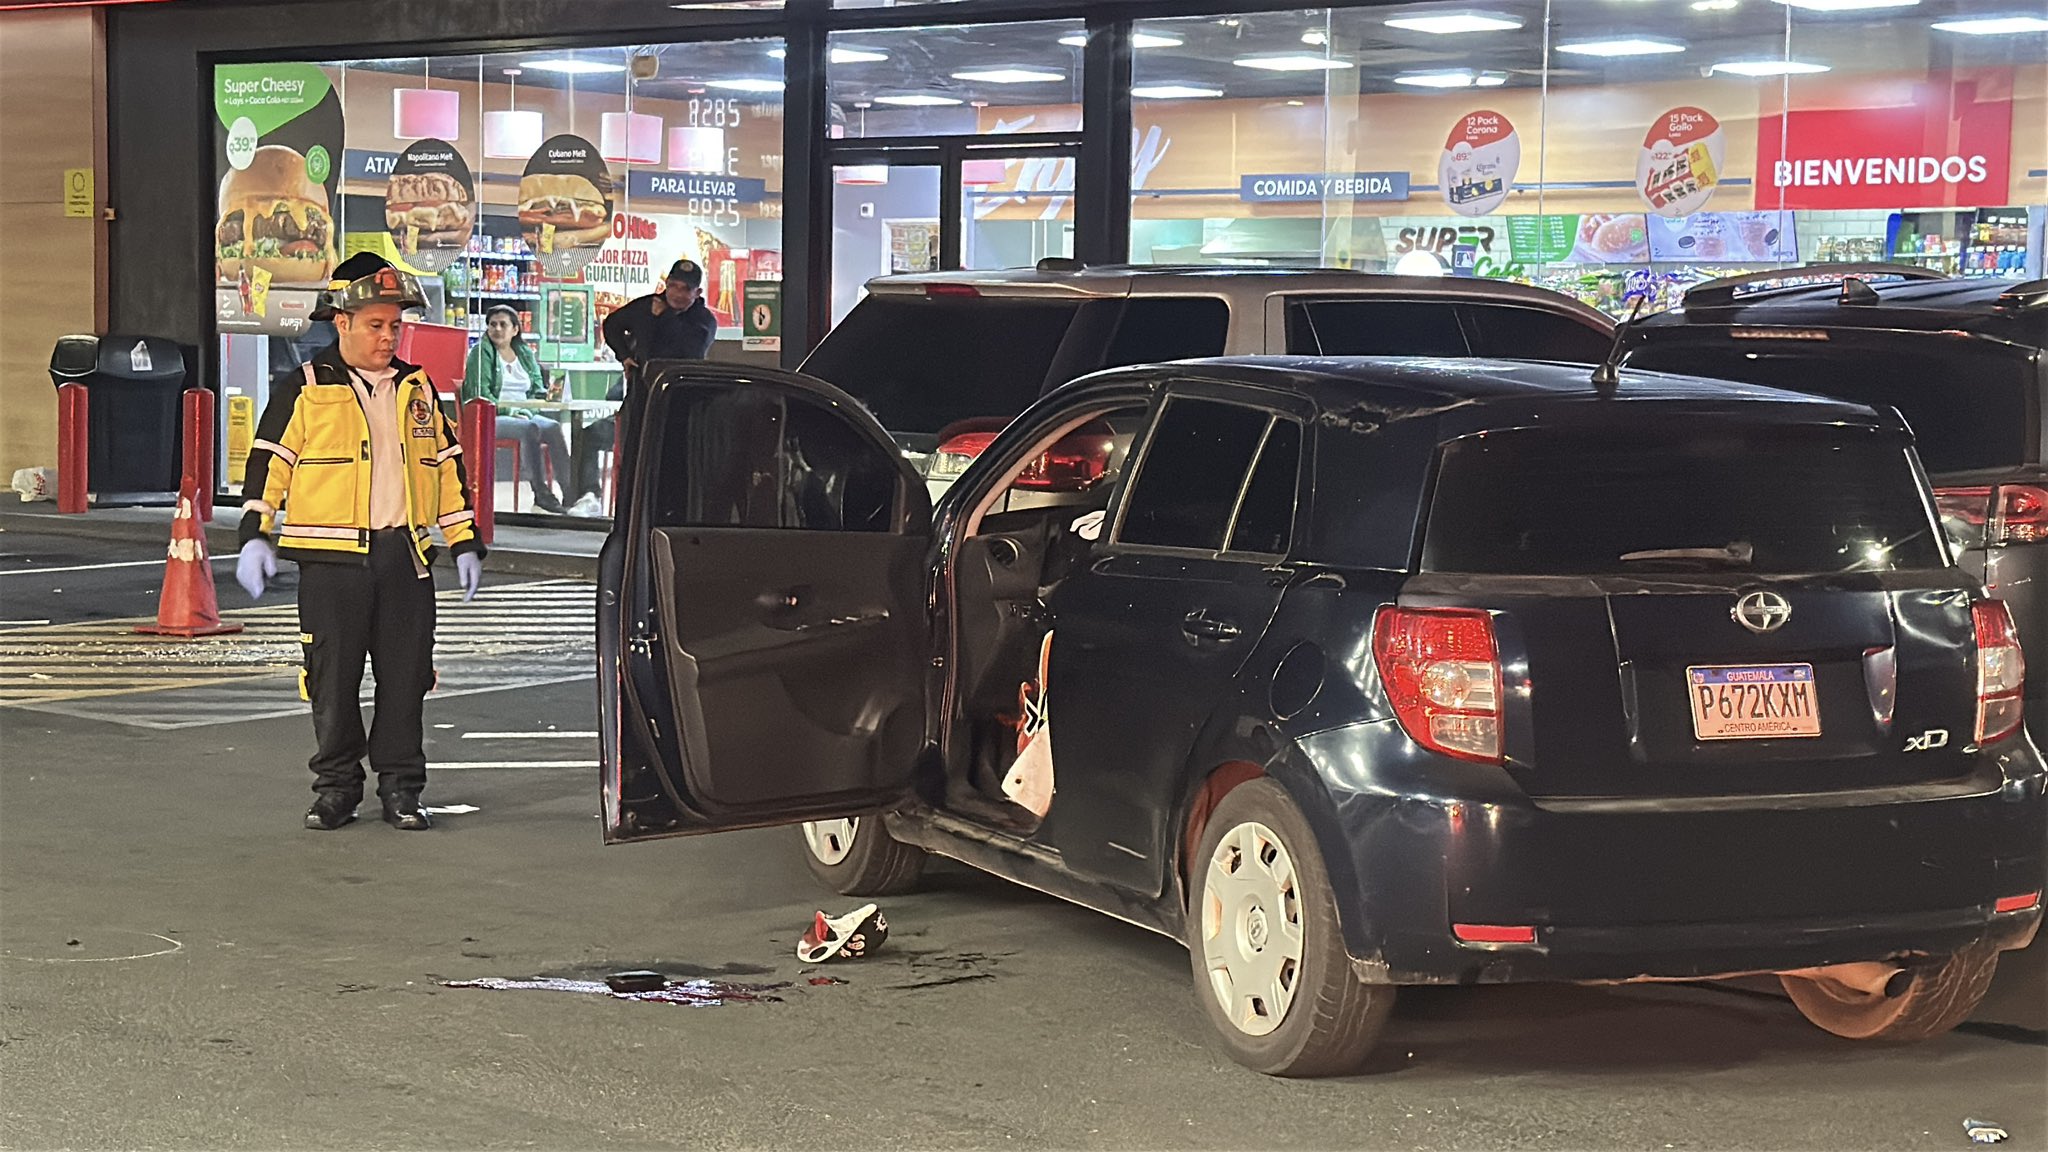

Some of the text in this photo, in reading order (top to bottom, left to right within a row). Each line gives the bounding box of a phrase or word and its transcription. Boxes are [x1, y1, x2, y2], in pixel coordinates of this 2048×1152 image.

[224, 77, 305, 97] Super Cheesy
[229, 96, 244, 107] Lays
[249, 96, 266, 105] Coca
[1467, 116, 1499, 126] 12 Pack
[1669, 113, 1704, 123] 15 Pack
[1466, 126, 1498, 135] Corona
[1668, 122, 1693, 132] Gallo
[364, 156, 399, 174] ATM
[1773, 155, 1987, 187] BIENVENIDOS
[651, 177, 736, 197] PARA LLEVAR
[1253, 177, 1393, 196] COMIDA Y BEBIDA
[621, 250, 649, 266] PIZZA
[585, 265, 650, 284] GUATEMALA
[1726, 671, 1775, 682] GUATEMALA
[1698, 683, 1811, 721] P672KXM
[1724, 723, 1757, 733] CENTRO
[1902, 729, 1949, 752] xD
